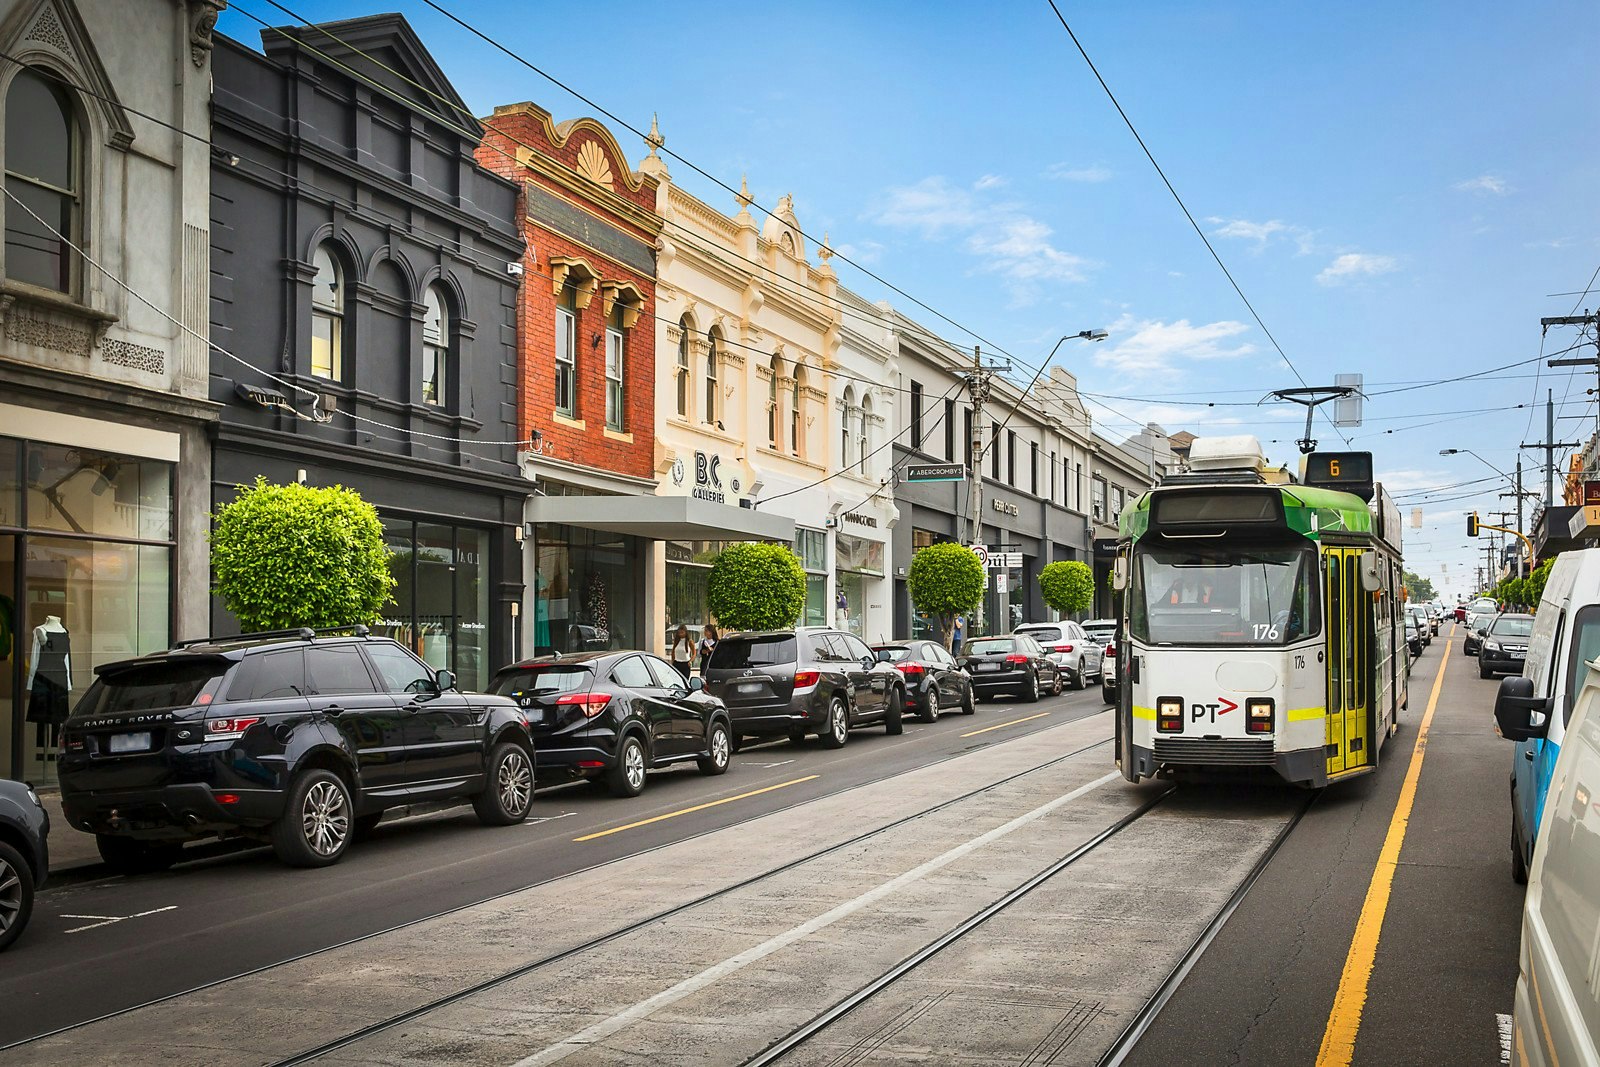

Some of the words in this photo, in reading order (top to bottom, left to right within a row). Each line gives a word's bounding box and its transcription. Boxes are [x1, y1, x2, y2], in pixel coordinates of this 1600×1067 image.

[1330, 459, 1340, 476] 6
[693, 487, 725, 504] GALLERIES
[386, 619, 403, 627] Studios
[1252, 624, 1279, 640] 176
[1294, 655, 1306, 669] 176
[128, 713, 173, 723] ROVER
